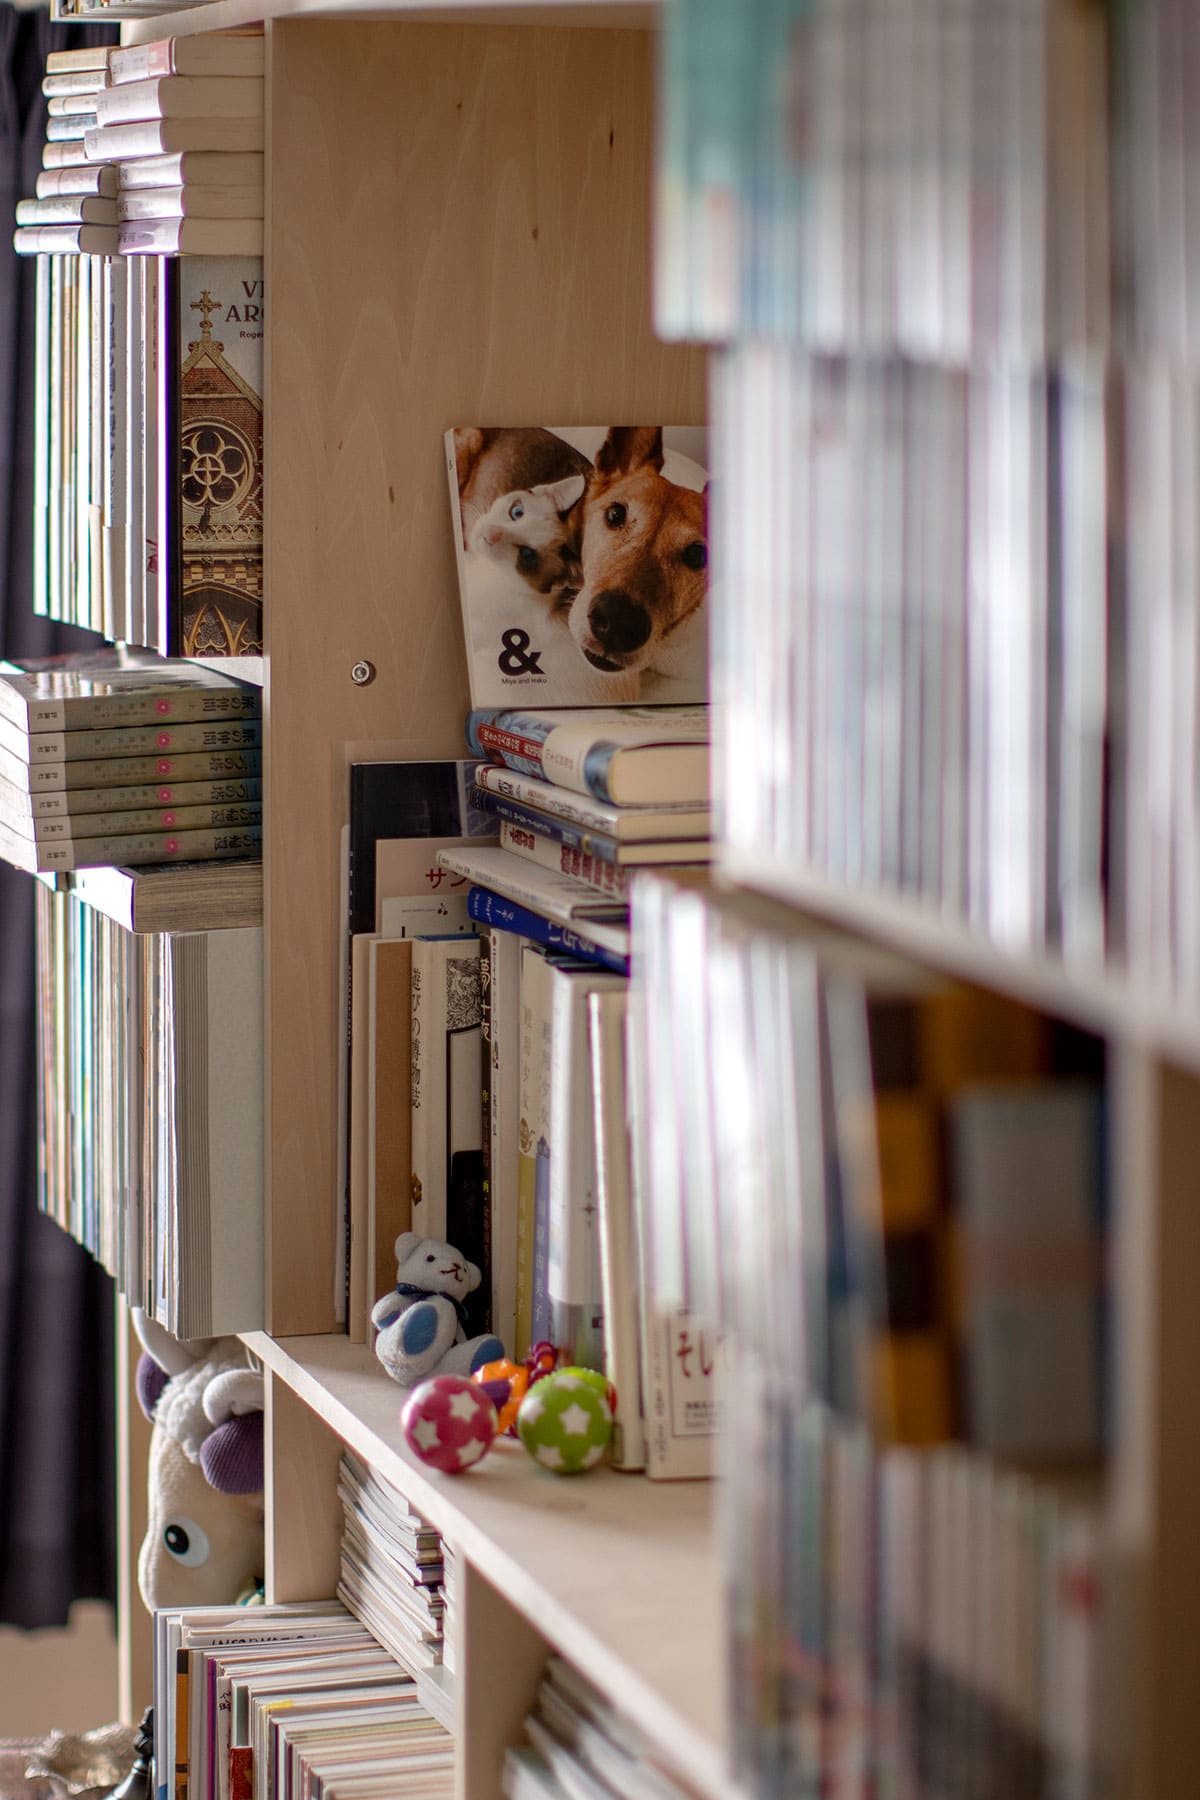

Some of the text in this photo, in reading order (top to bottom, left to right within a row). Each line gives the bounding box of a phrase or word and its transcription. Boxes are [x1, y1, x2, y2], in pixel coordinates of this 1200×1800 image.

[498, 628, 546, 676] &
[202, 695, 257, 713] 旅の仲間
[202, 728, 257, 745] 旅の仲間
